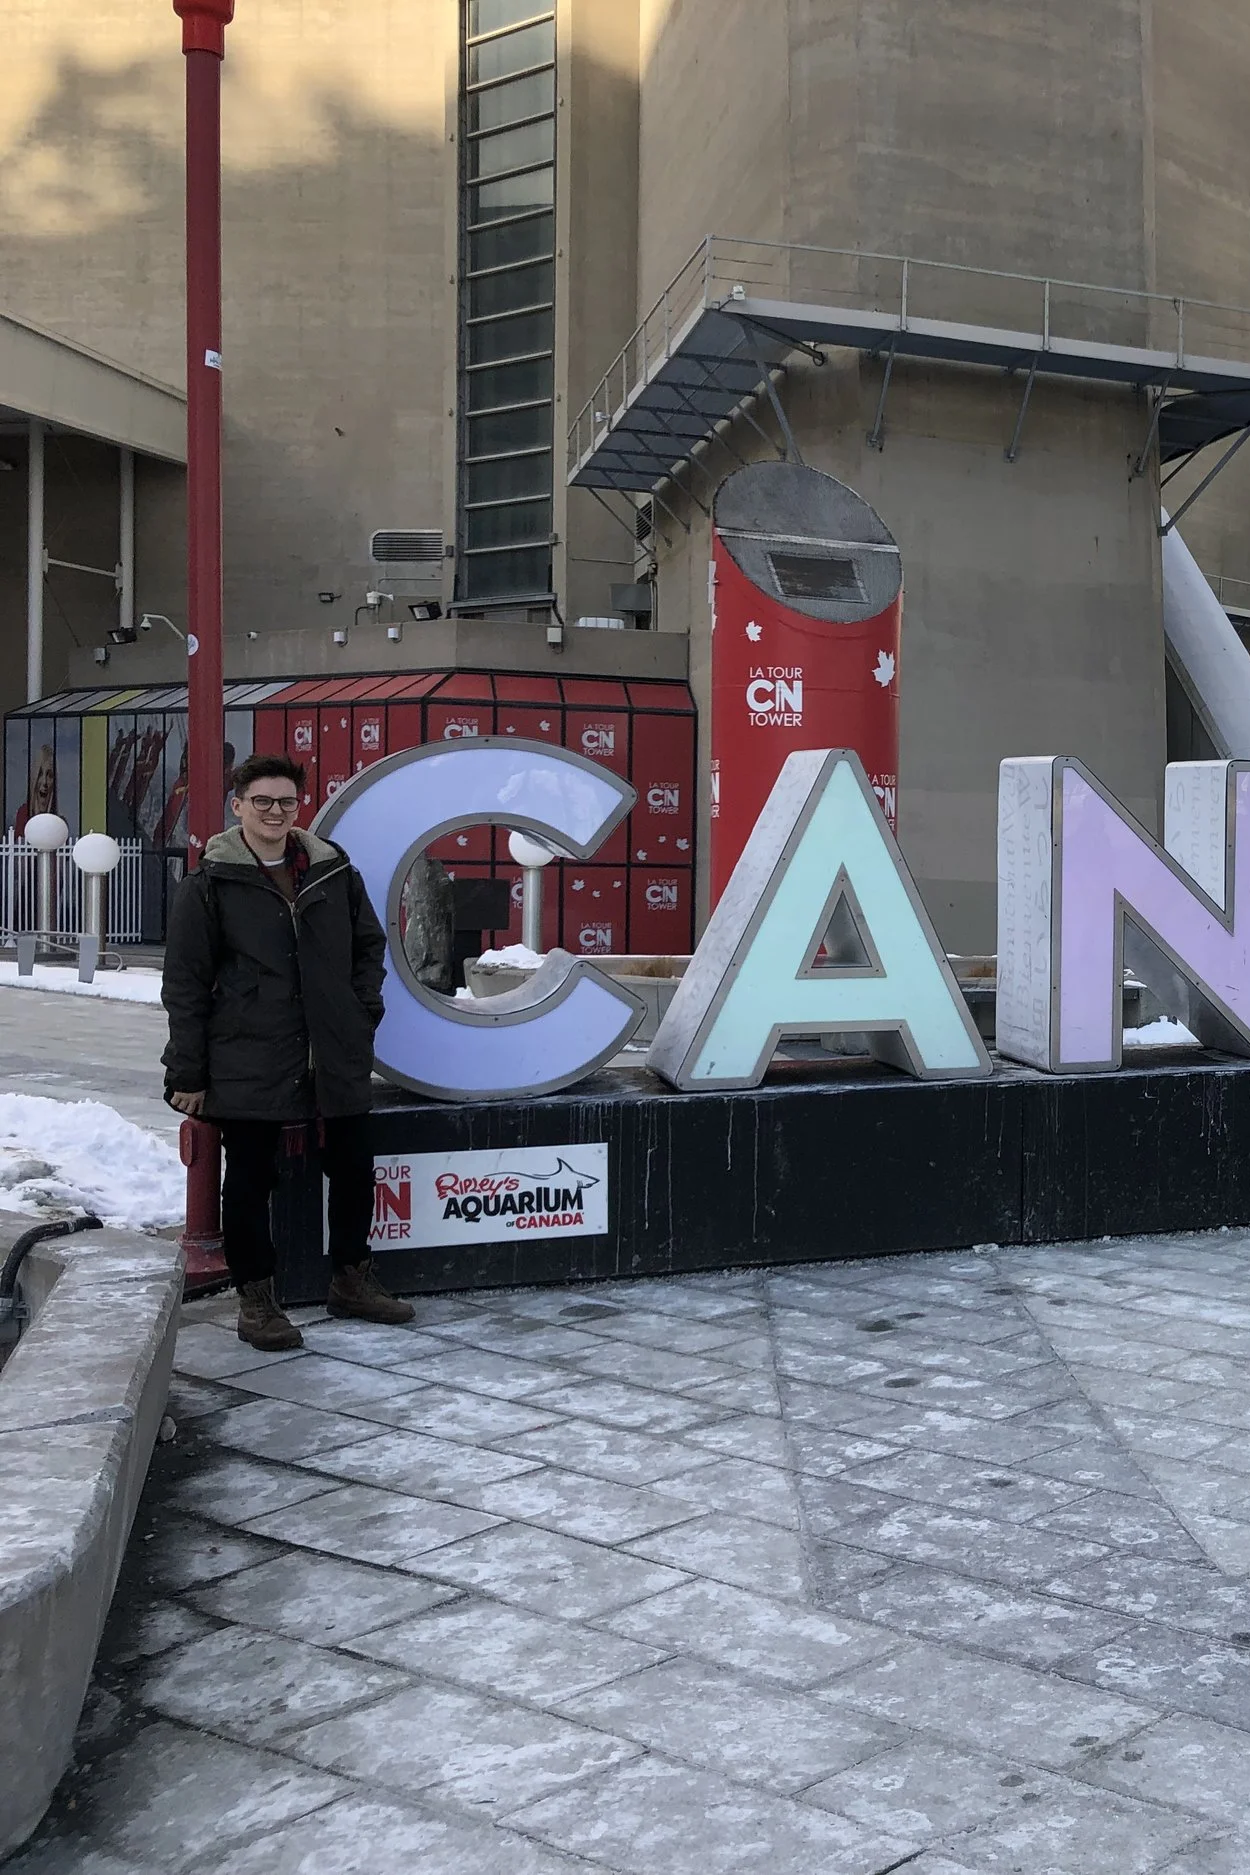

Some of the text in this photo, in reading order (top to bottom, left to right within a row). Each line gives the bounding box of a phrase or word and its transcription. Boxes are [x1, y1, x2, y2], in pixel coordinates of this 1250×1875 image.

[767, 667, 803, 679] TOUR
[746, 680, 803, 712] CN
[748, 713, 803, 727] TOWER
[294, 726, 312, 744] CN
[361, 724, 380, 743] CN
[443, 724, 478, 738] CN
[581, 730, 615, 748] CN
[647, 788, 679, 807] CN
[645, 885, 678, 903] CN
[579, 928, 612, 947] CN
[373, 1165, 411, 1181] OUR
[376, 1182, 411, 1222] N
[443, 1186, 583, 1222] AQUARIUM
[515, 1213, 584, 1230] CANADA
[368, 1223, 411, 1241] WER
